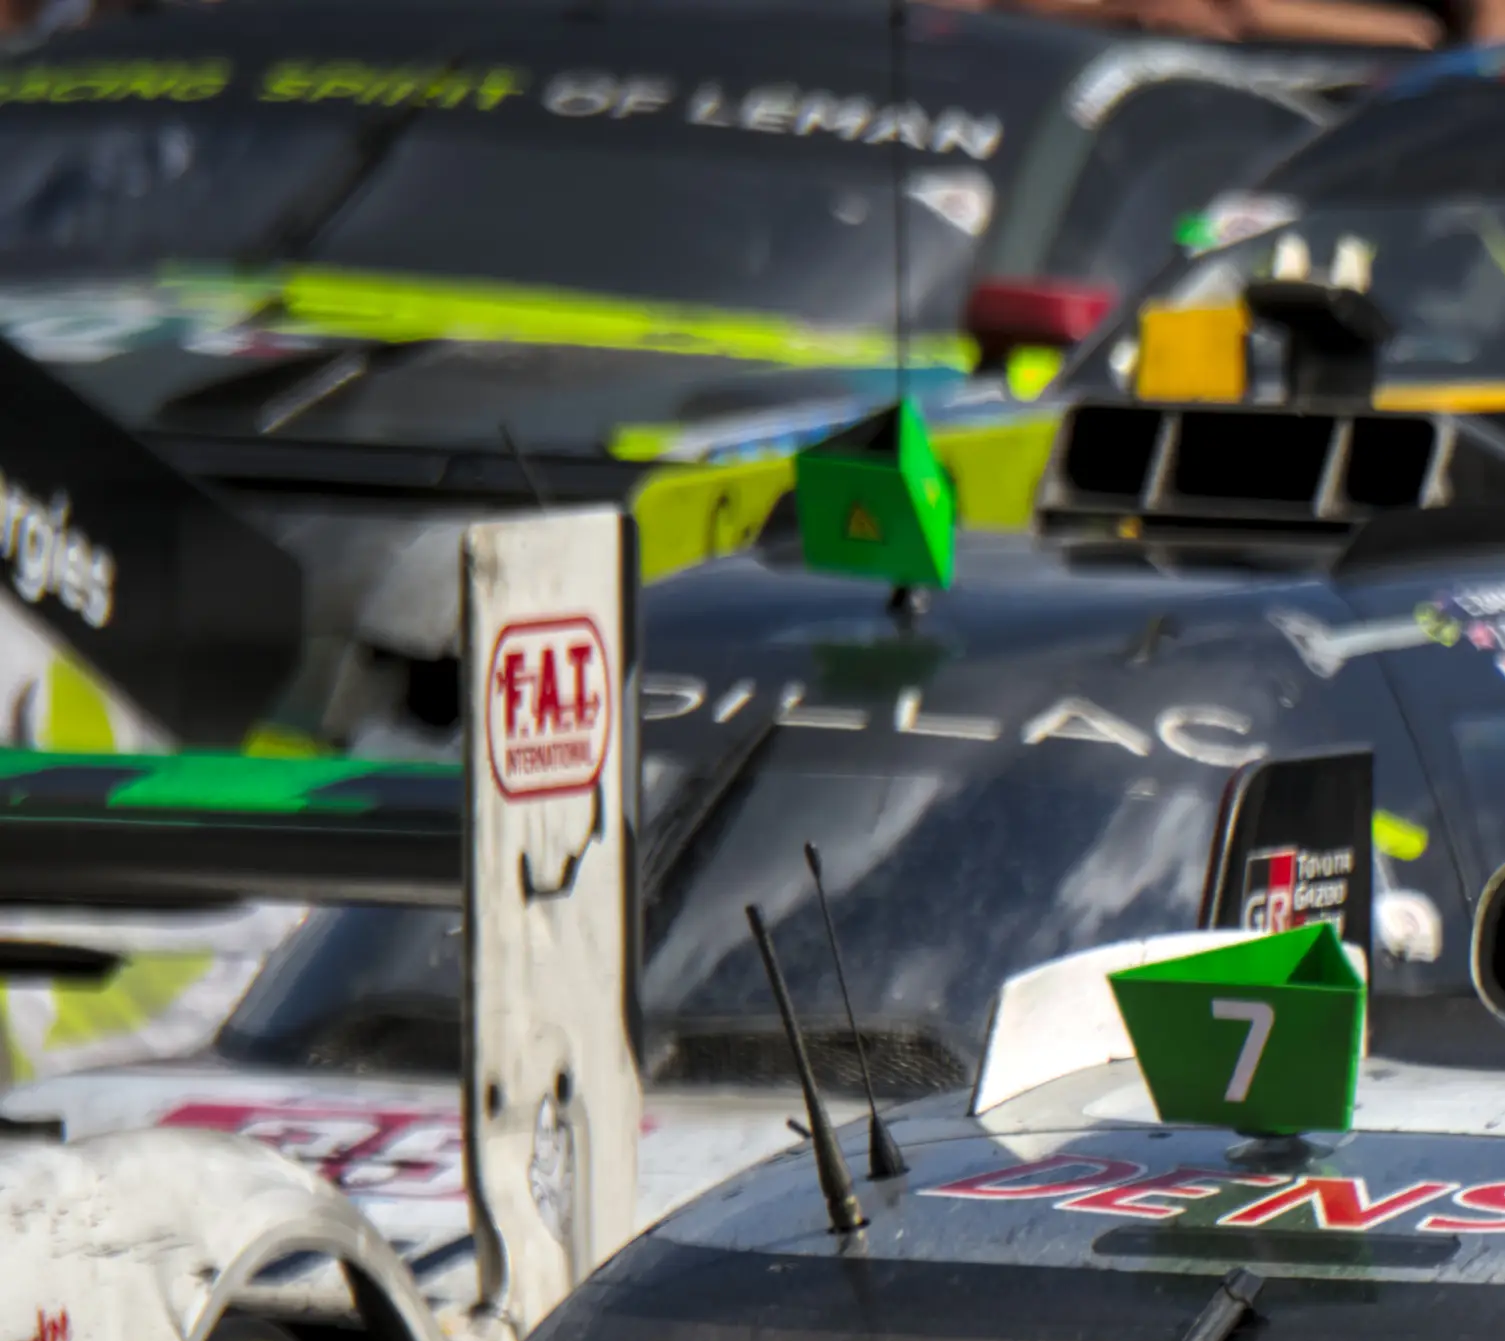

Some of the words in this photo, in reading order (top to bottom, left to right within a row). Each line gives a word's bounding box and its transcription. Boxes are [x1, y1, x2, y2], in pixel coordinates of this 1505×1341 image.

[0, 60, 230, 103] ACING
[545, 70, 675, 120] OF
[505, 738, 592, 778] INTERNATIONAL
[1210, 999, 1276, 1103] 7
